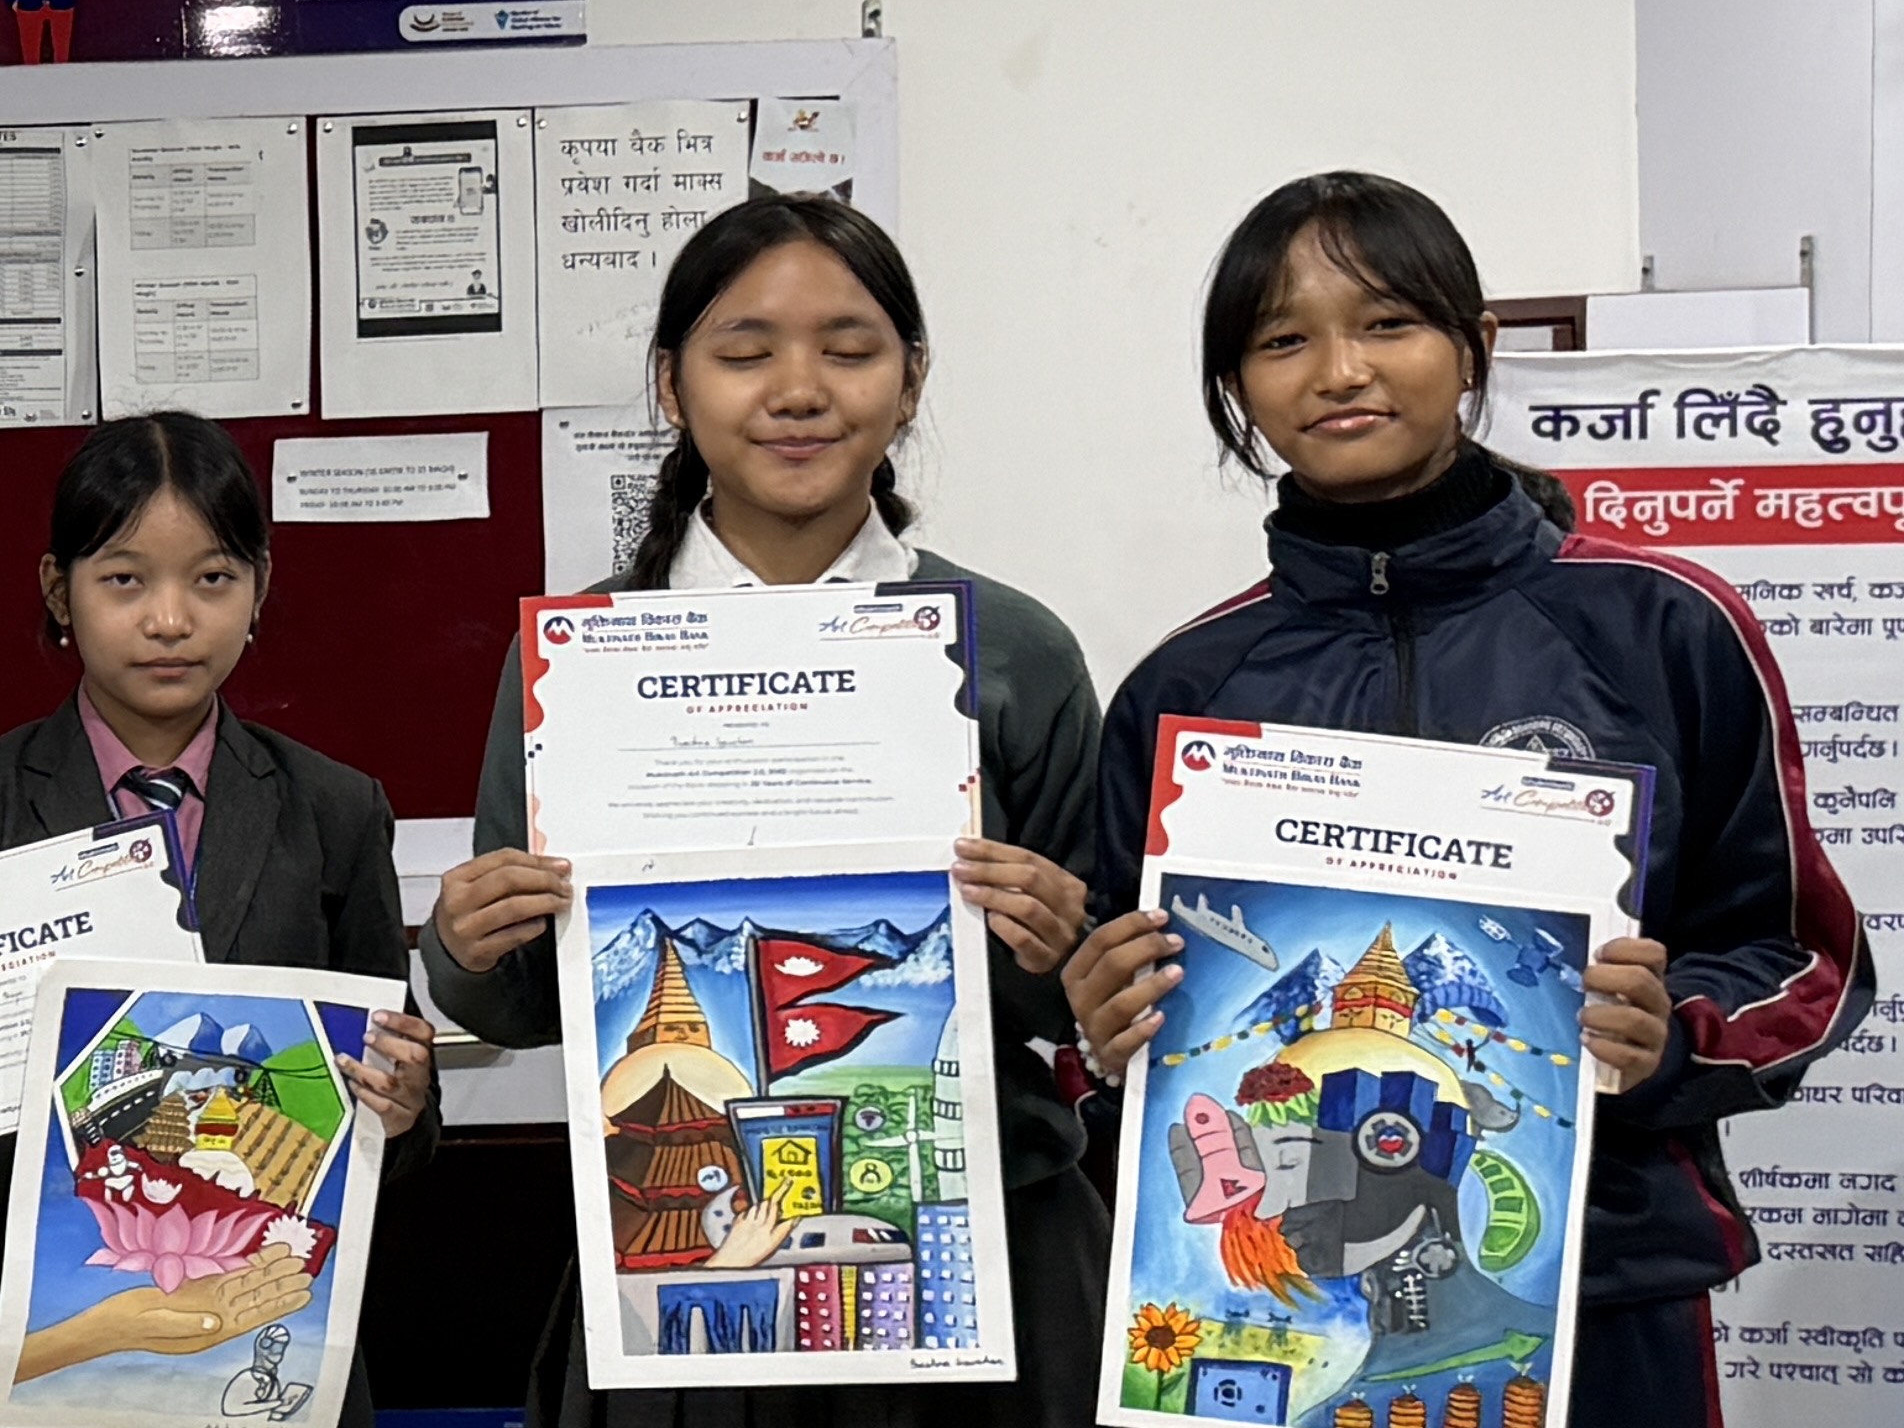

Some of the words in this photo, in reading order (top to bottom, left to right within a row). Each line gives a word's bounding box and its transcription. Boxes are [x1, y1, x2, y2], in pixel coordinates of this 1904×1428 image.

[560, 138, 617, 165] कृपया
[678, 129, 714, 155] भित्र
[560, 172, 610, 197] प्रवेश
[623, 167, 660, 194] गर्दा
[561, 250, 639, 270] धन्यवाद
[1529, 389, 1660, 441] कर्जा
[1585, 479, 1744, 536] दिनुपर्ने
[637, 670, 856, 700] CERTIFICATE
[709, 701, 808, 714] APPRECIATION
[1275, 818, 1513, 870] CERTIFICATE
[1738, 1321, 1790, 1345] कर्जा
